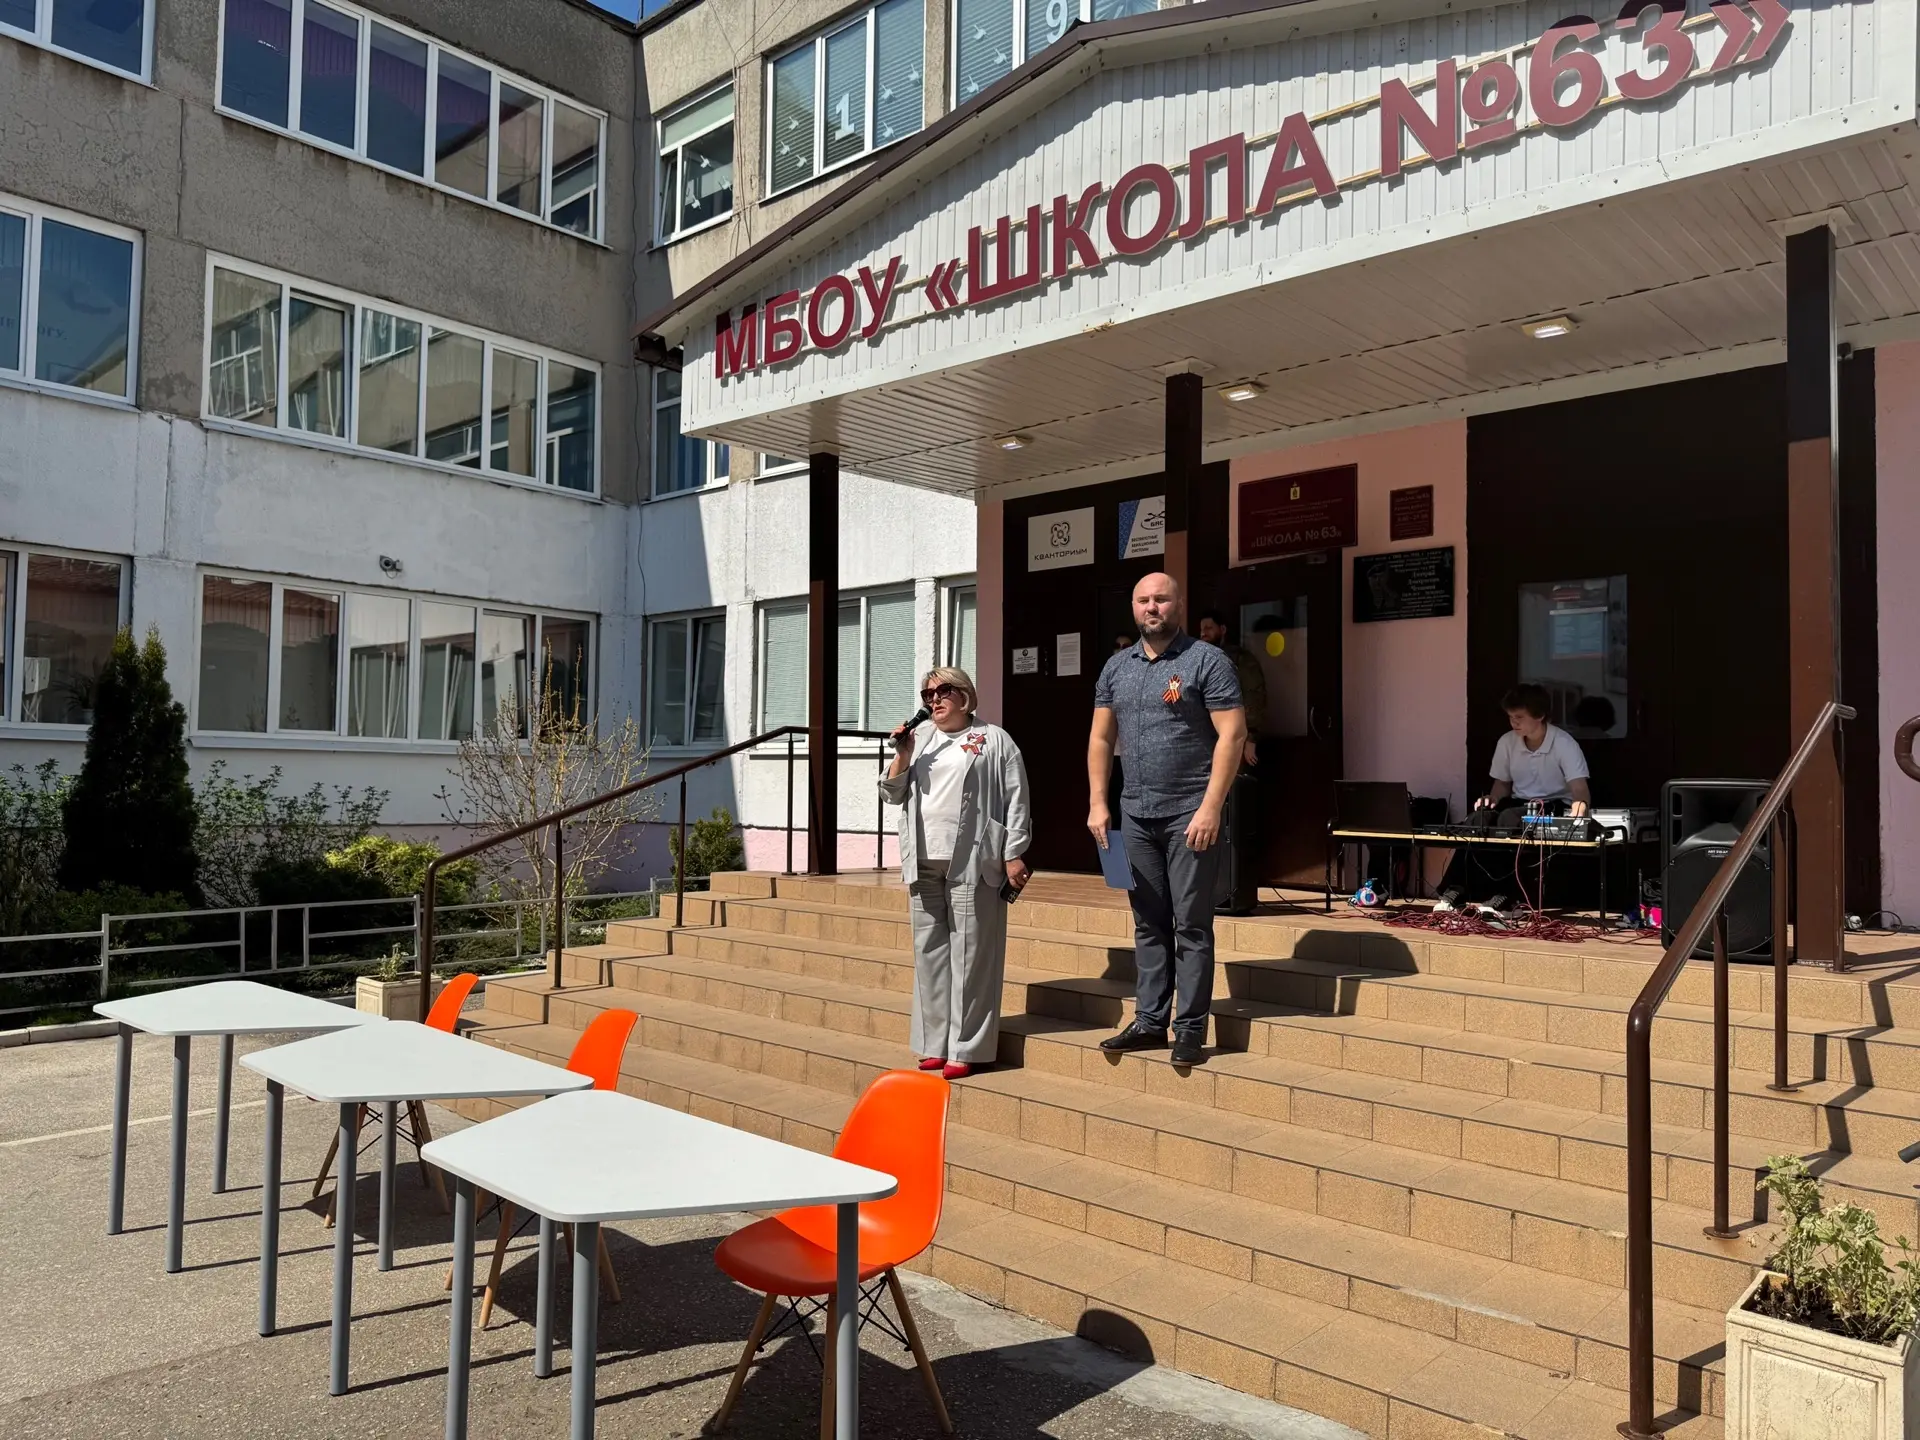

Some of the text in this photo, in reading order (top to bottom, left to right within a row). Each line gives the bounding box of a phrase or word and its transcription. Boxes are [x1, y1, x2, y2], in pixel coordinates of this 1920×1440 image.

[1046, 0, 1069, 44] 9
[834, 93, 856, 140] 1
[715, 255, 902, 379] МБОУ
[925, 111, 1339, 312] «ШКОЛА
[1034, 548, 1088, 561] КВАНТОРИУМ
